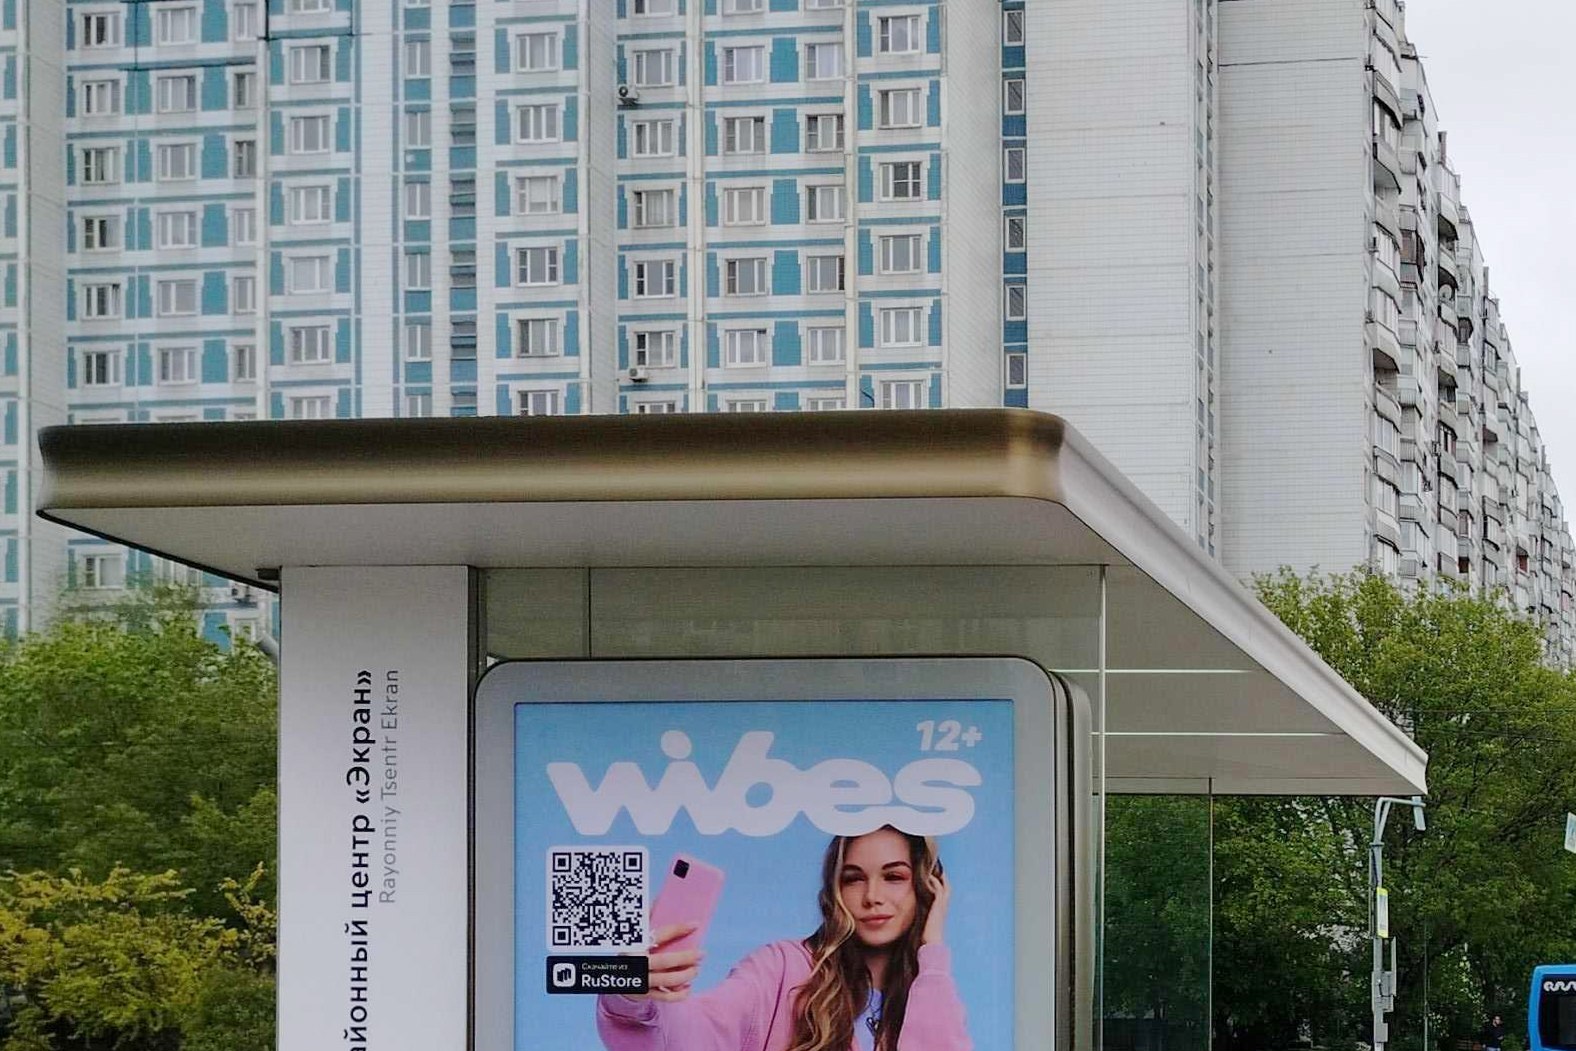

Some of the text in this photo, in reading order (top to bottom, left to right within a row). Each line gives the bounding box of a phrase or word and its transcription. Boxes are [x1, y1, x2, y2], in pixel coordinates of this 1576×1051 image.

[346, 669, 376, 804] «Экран»
[546, 730, 984, 837] wibes
[915, 719, 983, 752] 12+
[379, 669, 400, 904] Rayonniy Tsentr Ekran
[351, 814, 375, 908] центр
[581, 973, 642, 988] RuStore
